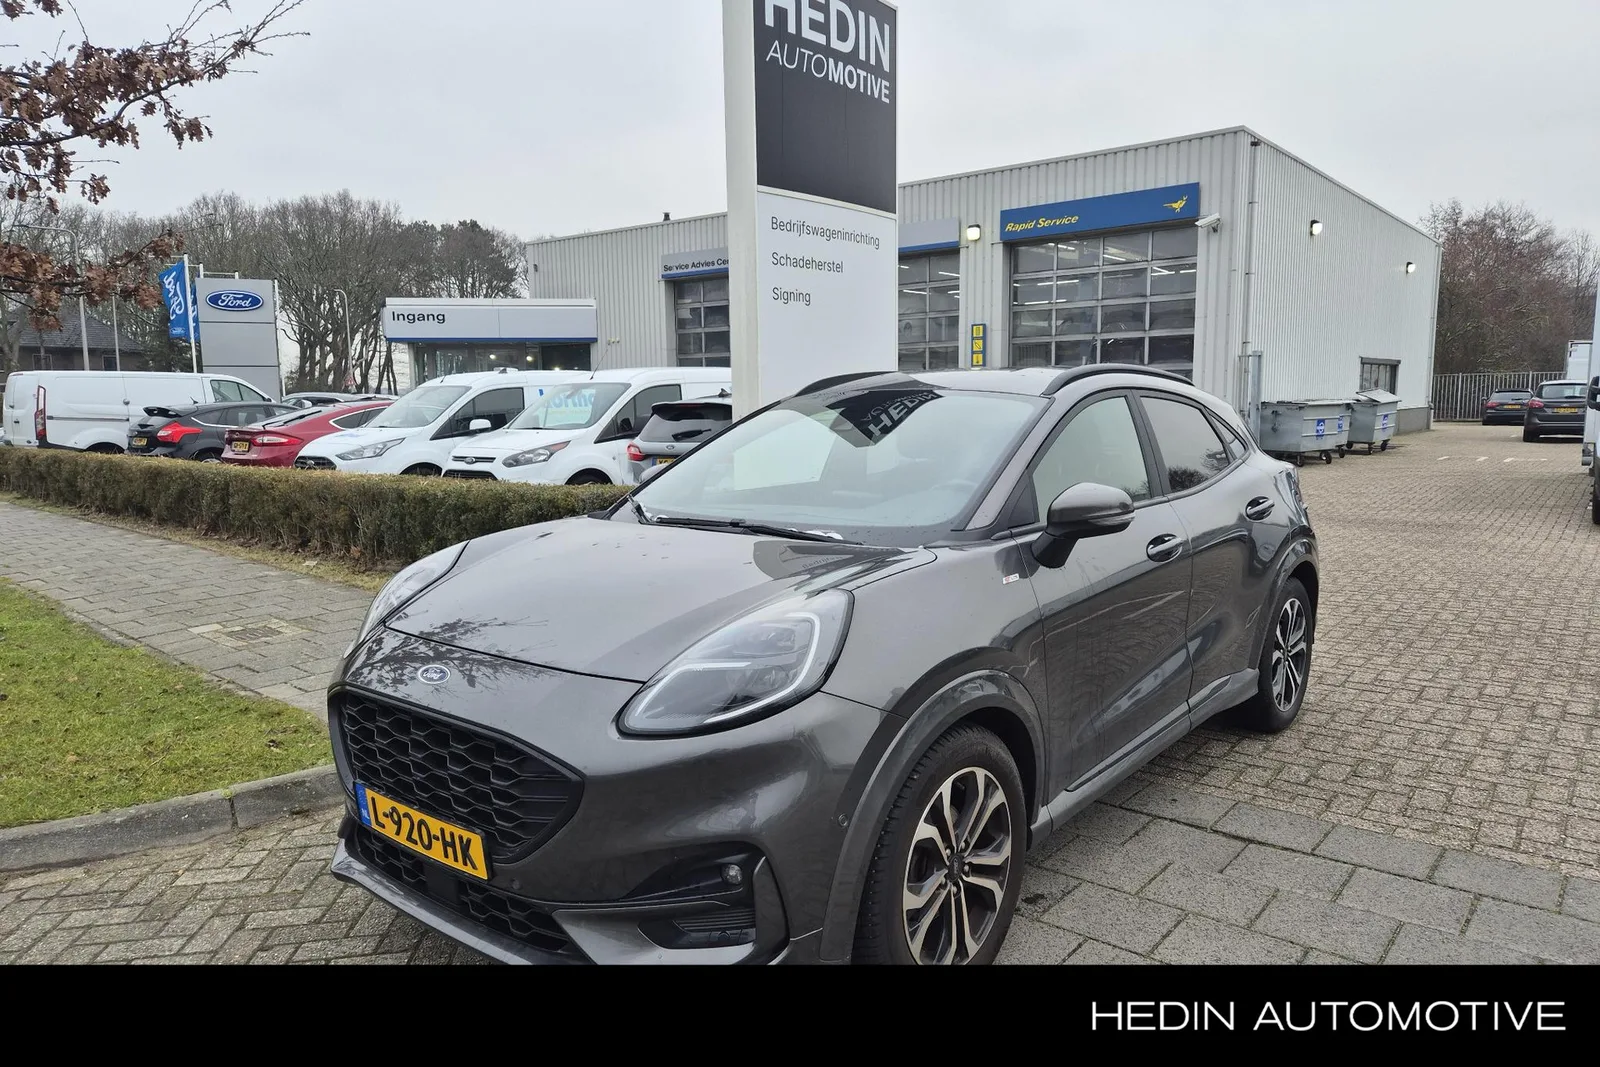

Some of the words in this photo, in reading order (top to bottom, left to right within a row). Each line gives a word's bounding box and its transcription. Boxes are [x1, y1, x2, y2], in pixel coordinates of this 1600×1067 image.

[766, 40, 890, 104] AUTOMOTIVE
[771, 216, 880, 250] Bedrijfswageninrichting
[1005, 220, 1035, 232] Rapid
[1037, 215, 1079, 228] Service
[691, 259, 716, 269] Advies
[771, 251, 844, 273] Schadeherstel
[218, 294, 252, 307] Ford
[772, 286, 811, 306] Signing
[392, 311, 446, 324] Ingang
[370, 796, 479, 871] L-920-HK
